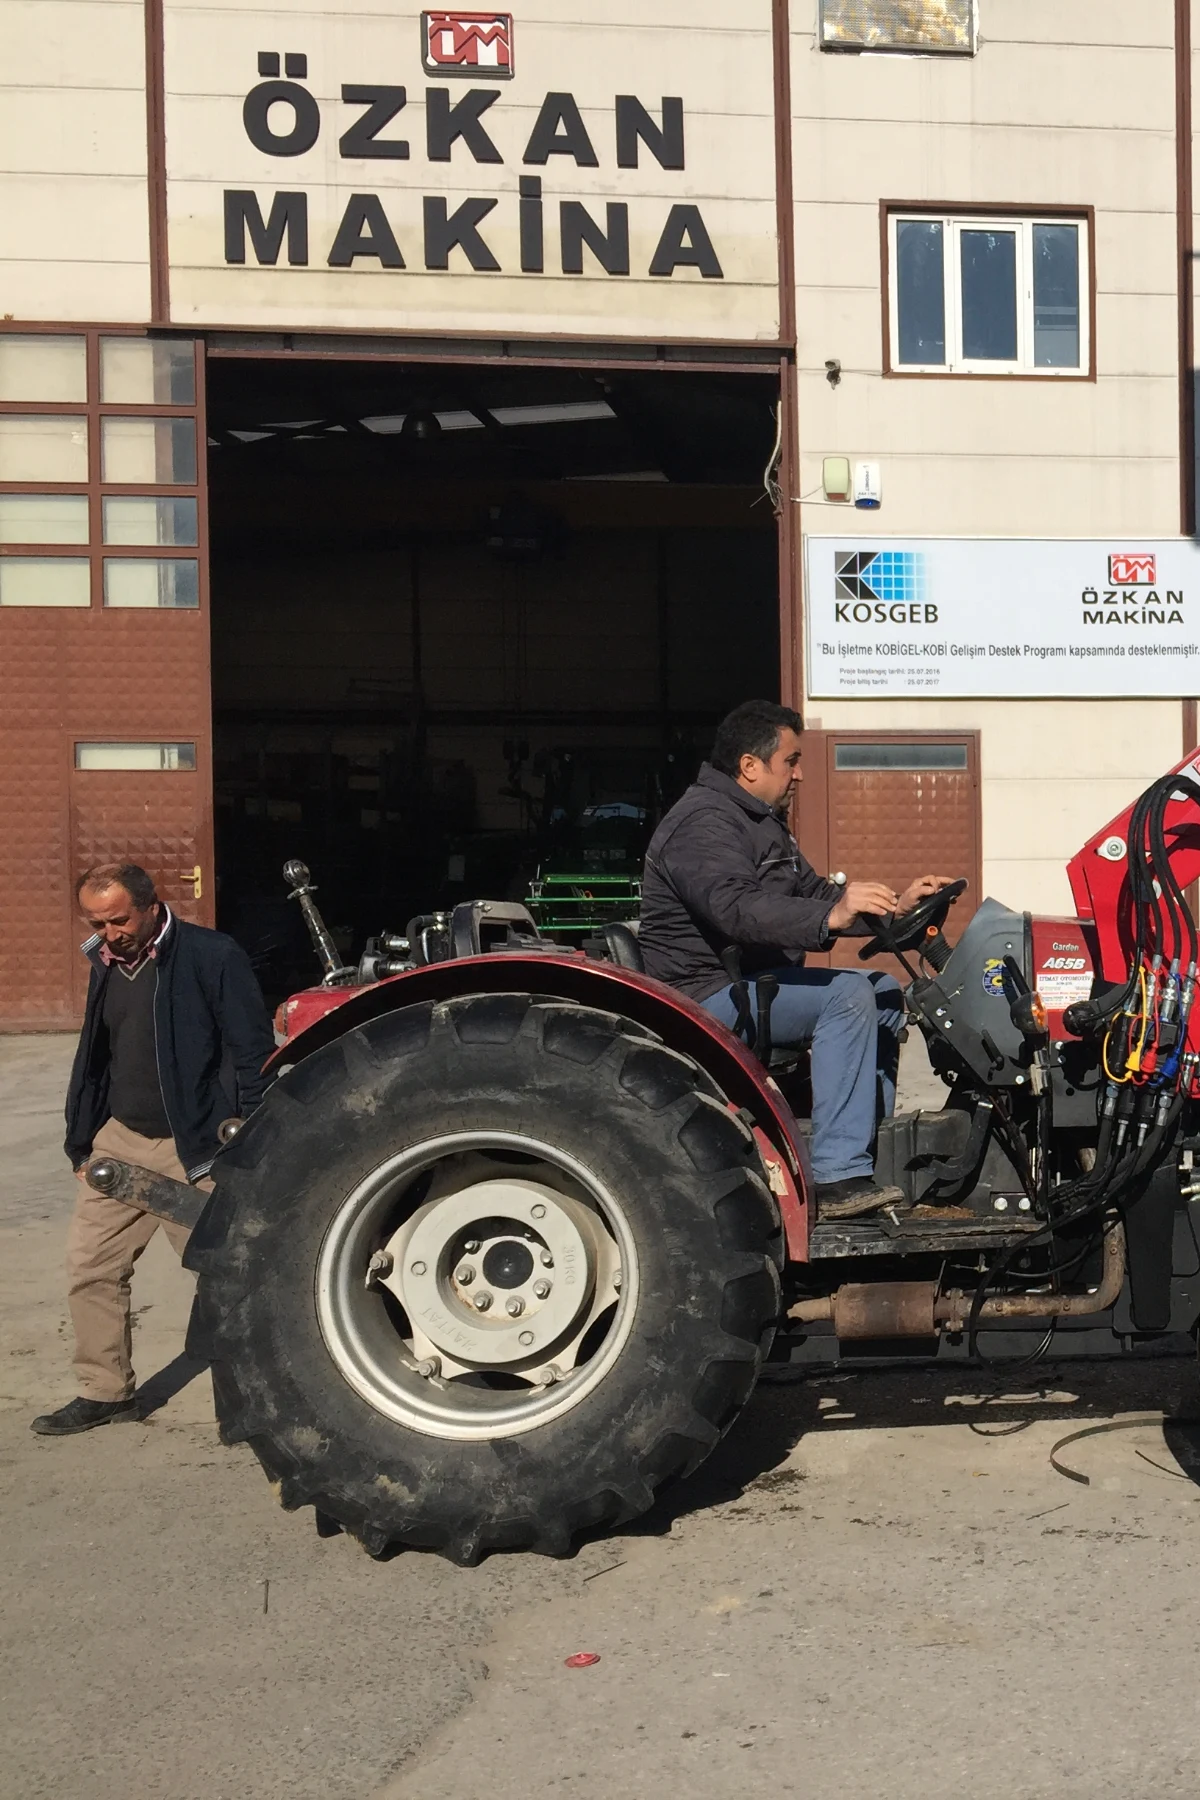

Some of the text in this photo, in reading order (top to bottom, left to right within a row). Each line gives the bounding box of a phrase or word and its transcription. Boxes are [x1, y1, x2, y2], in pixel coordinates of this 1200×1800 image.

[242, 51, 686, 171] ÖZKAN
[223, 174, 724, 279] MAKİNA
[1081, 587, 1184, 605] ÖZKAN
[835, 602, 939, 624] KOSGEB
[1083, 606, 1185, 625] MAKİNA
[838, 640, 873, 659] İşletme
[875, 640, 948, 657] KOBİGEL-KOBİ
[950, 643, 986, 660] Gelişim
[988, 643, 1022, 657] Destek
[1023, 643, 1067, 660] Programı
[1069, 644, 1126, 660] kapsamında
[839, 667, 856, 676] Proje
[839, 678, 856, 687] Proje
[872, 678, 888, 686] tarihi
[1052, 941, 1080, 952] Garden
[1041, 957, 1087, 970] A65B
